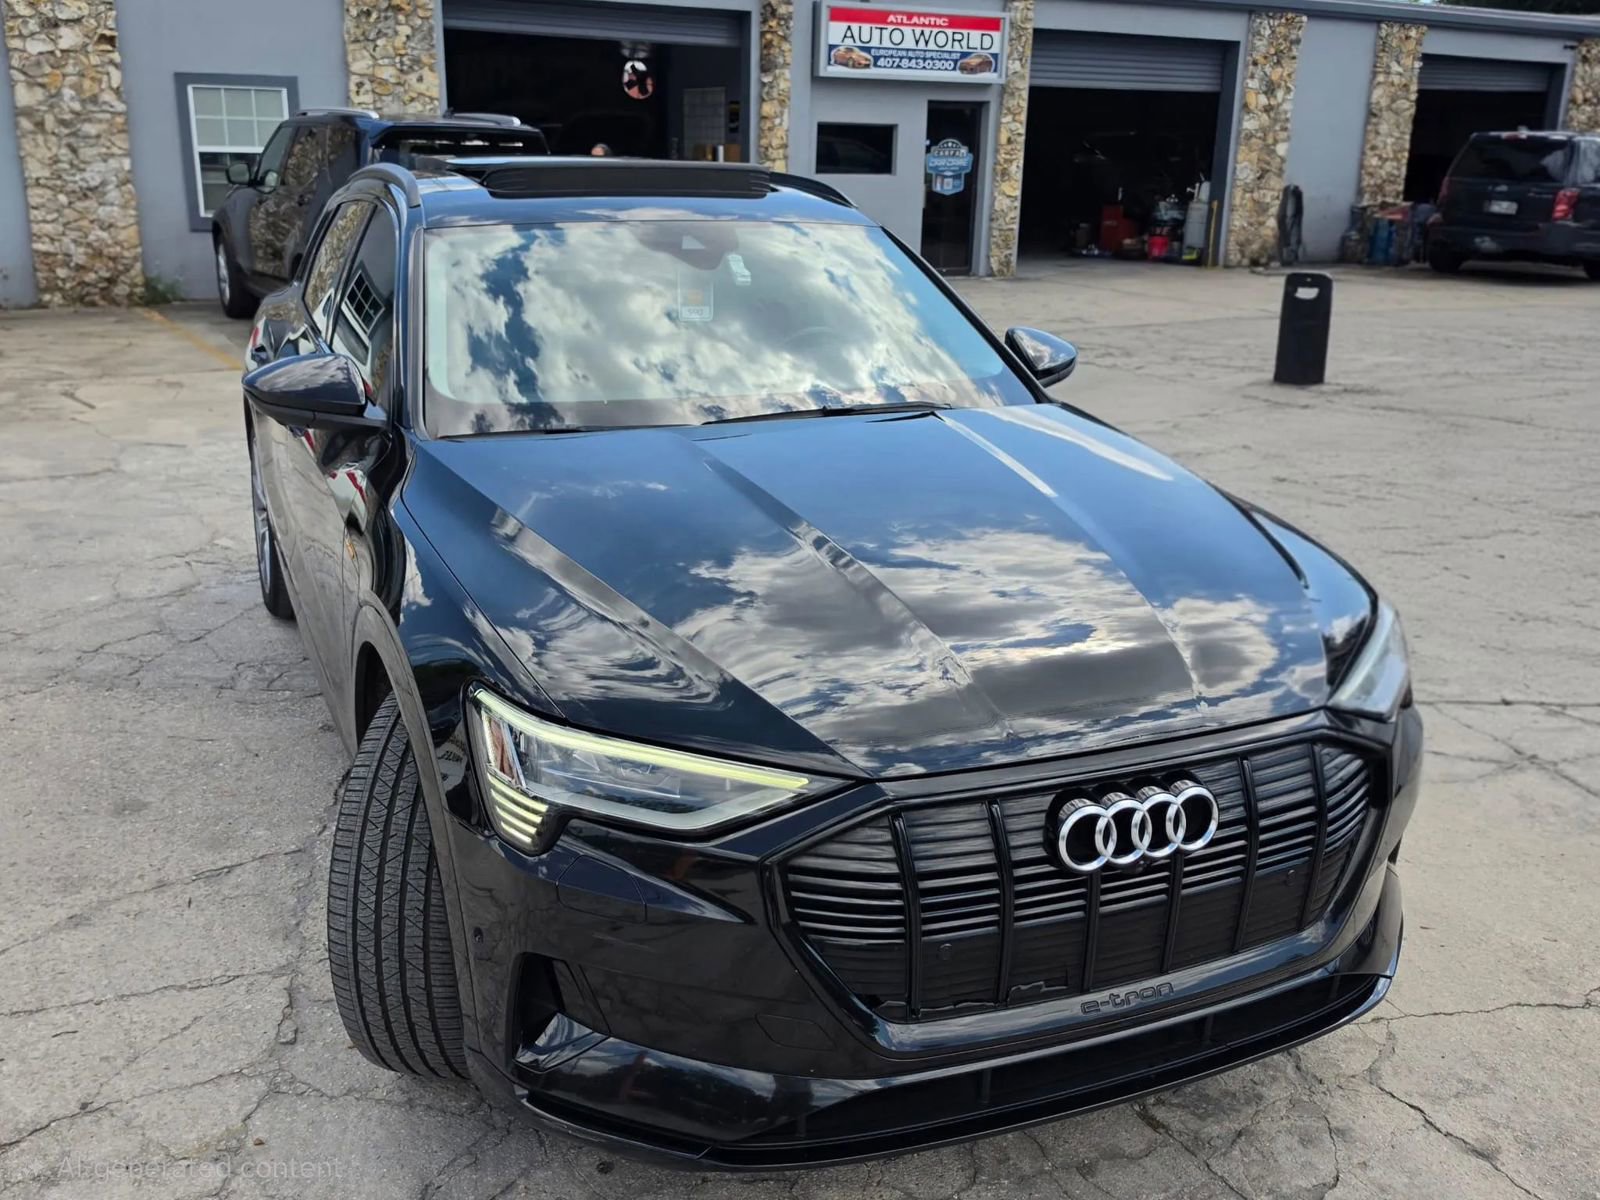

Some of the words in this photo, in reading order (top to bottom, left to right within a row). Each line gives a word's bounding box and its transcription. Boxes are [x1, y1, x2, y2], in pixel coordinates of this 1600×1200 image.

[887, 14, 949, 26] ATLANTIC
[841, 25, 905, 46] AUTO
[912, 28, 994, 51] WORLD
[870, 48, 907, 57] EUROPEAN
[908, 50, 925, 58] AUTO
[925, 51, 961, 59] SPECIALIST
[877, 57, 954, 70] 407-843-0300
[1080, 982, 1174, 1015] e-tron
